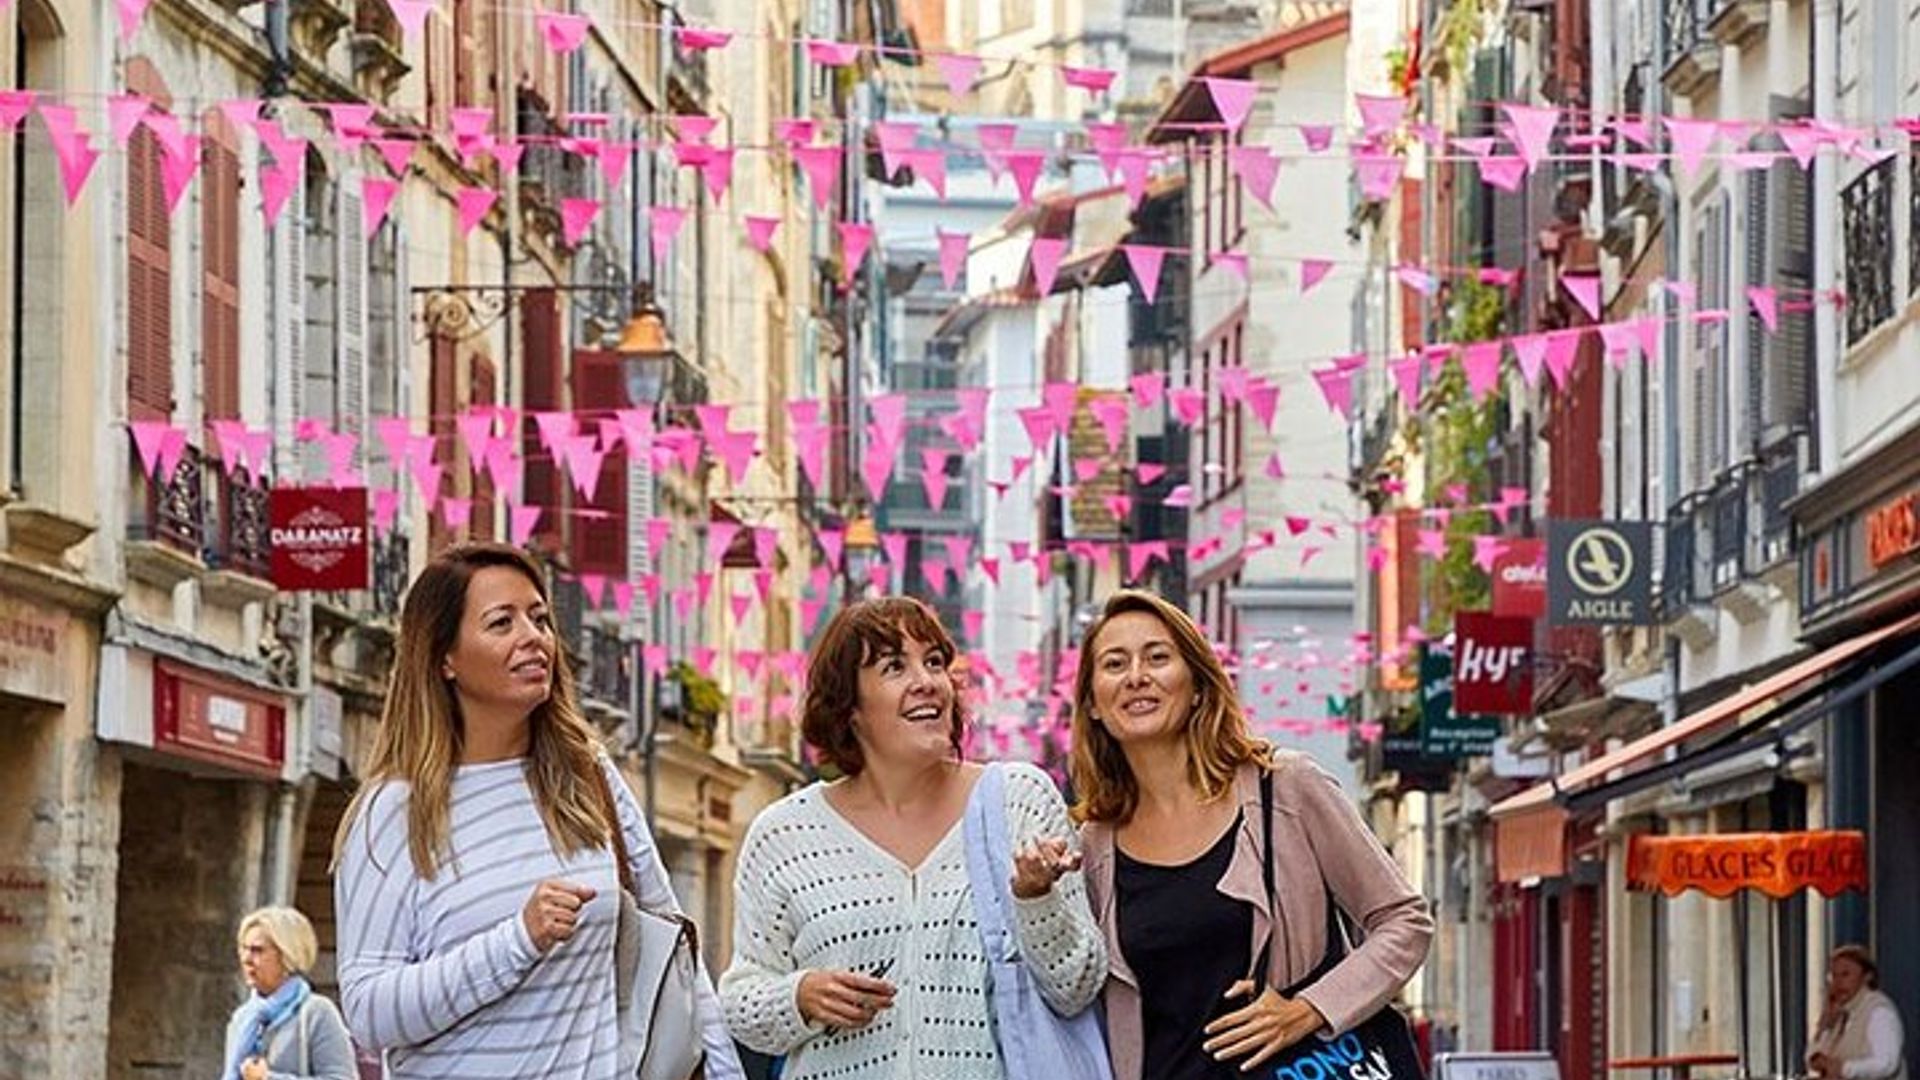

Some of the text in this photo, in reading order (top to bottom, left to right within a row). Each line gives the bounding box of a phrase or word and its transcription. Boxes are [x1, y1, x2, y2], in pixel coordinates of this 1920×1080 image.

[271, 526, 361, 546] DARANATZ
[1567, 601, 1633, 619] AIGLE
[1671, 850, 1777, 881] GLACES
